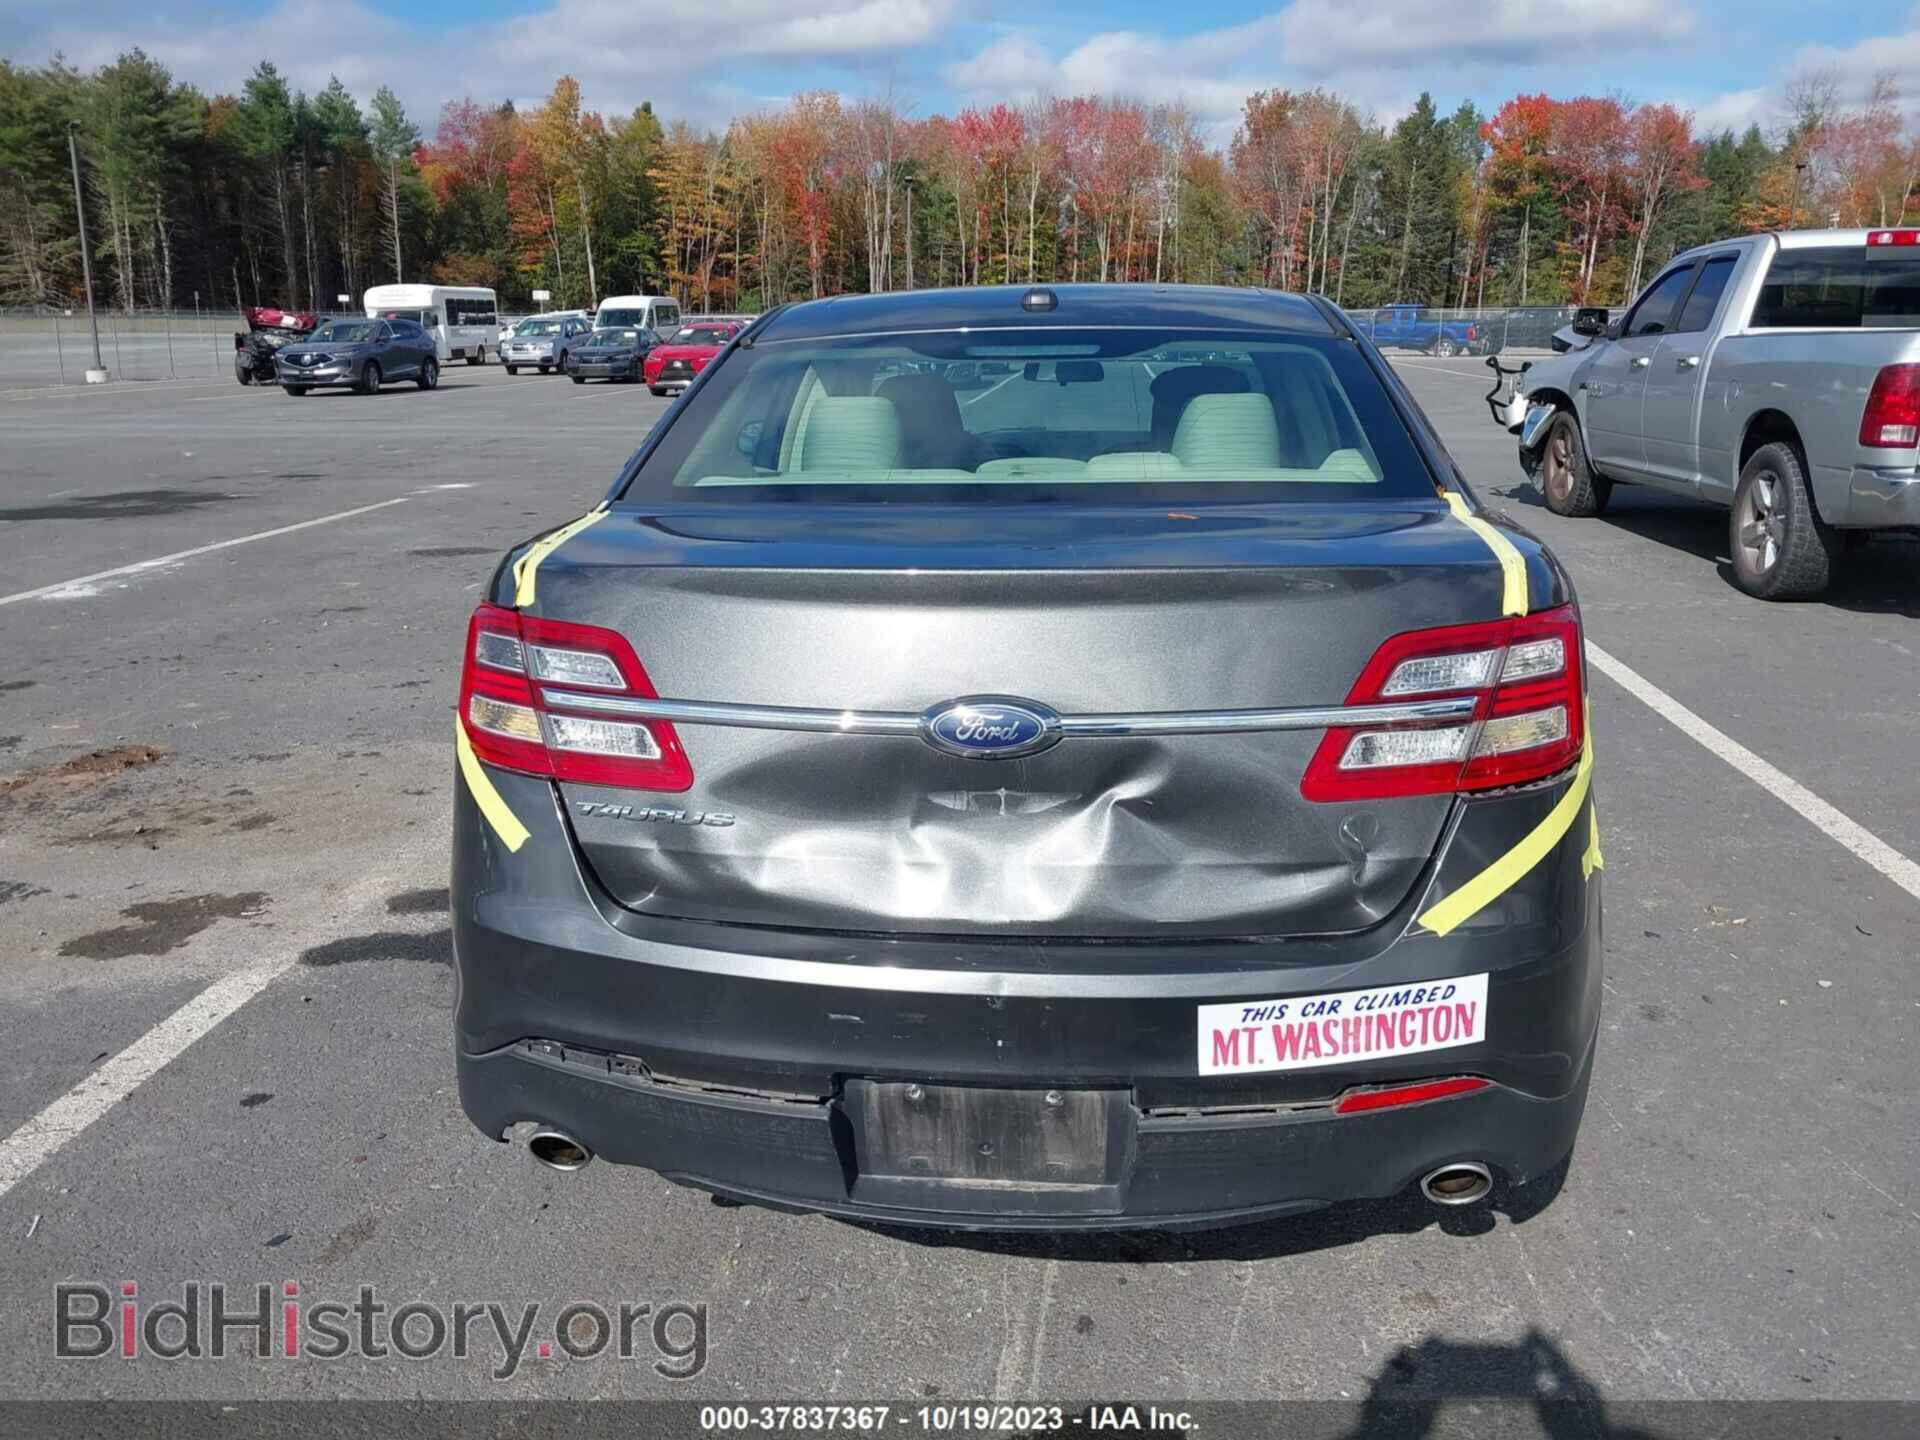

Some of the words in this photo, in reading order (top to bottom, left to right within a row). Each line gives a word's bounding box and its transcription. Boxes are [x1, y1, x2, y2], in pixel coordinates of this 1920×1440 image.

[956, 711, 1020, 740] Ford
[576, 802, 735, 827] TAURUS
[1241, 1004, 1289, 1022] THIS
[1301, 999, 1342, 1017] CAR
[1354, 984, 1457, 1011] CLIMBED
[1212, 1026, 1264, 1067] MT.
[1272, 1001, 1477, 1062] WASHINGTON
